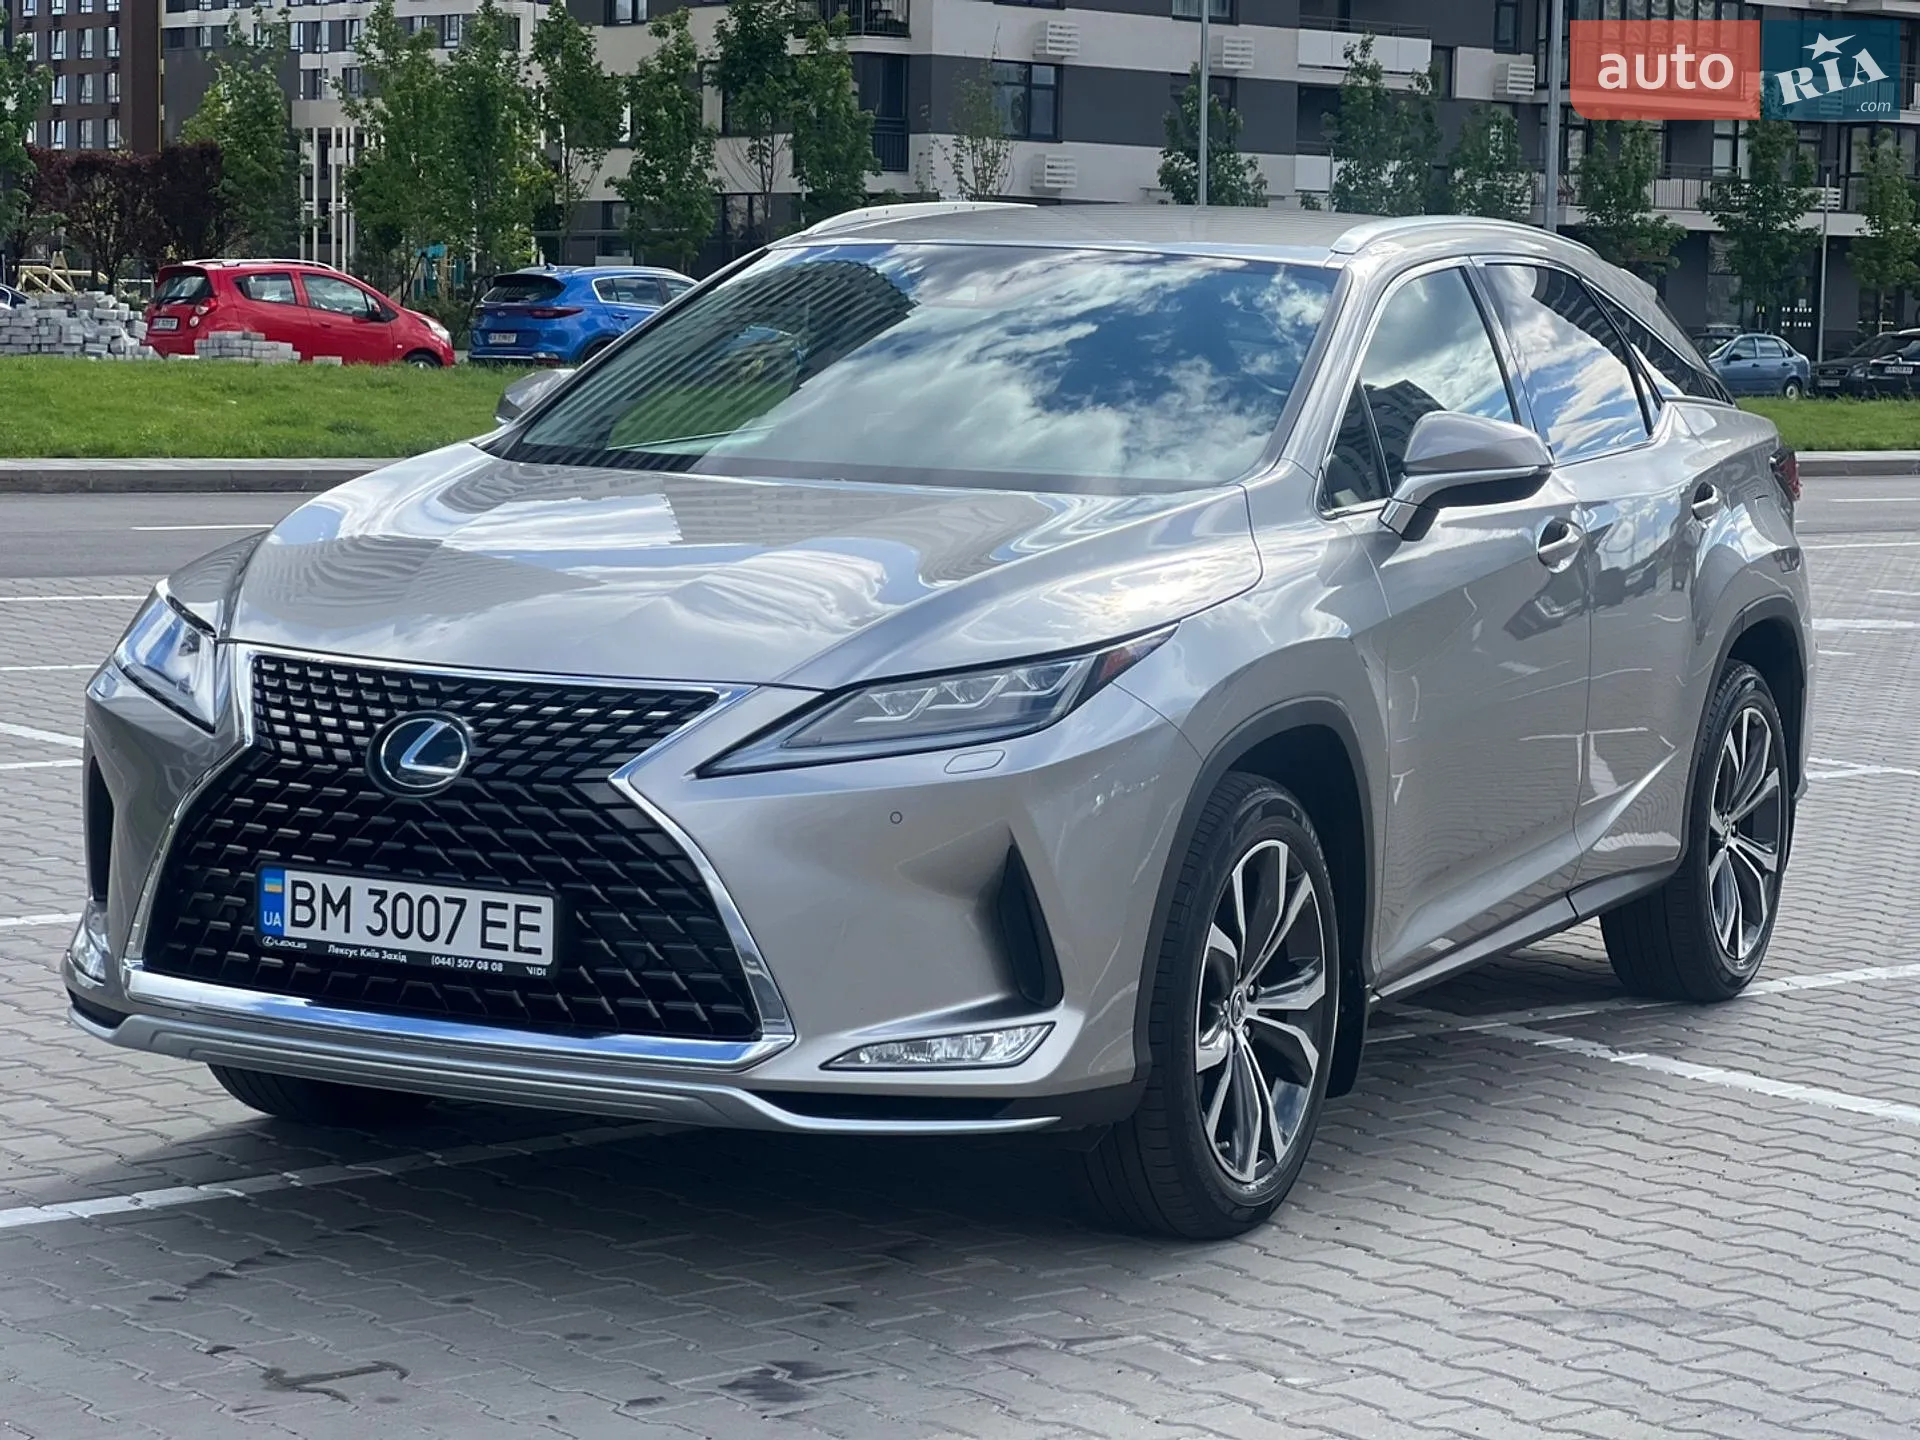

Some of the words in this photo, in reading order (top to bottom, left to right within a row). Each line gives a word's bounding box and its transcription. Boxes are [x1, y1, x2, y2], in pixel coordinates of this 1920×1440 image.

[263, 911, 282, 927] UA
[290, 879, 352, 934] BM
[366, 888, 467, 946] 3007
[480, 900, 543, 956] EE
[328, 945, 358, 958] Лексус
[360, 948, 379, 959] Київ
[381, 950, 407, 963] Захід
[431, 955, 455, 968] (044)
[456, 958, 474, 968] 507
